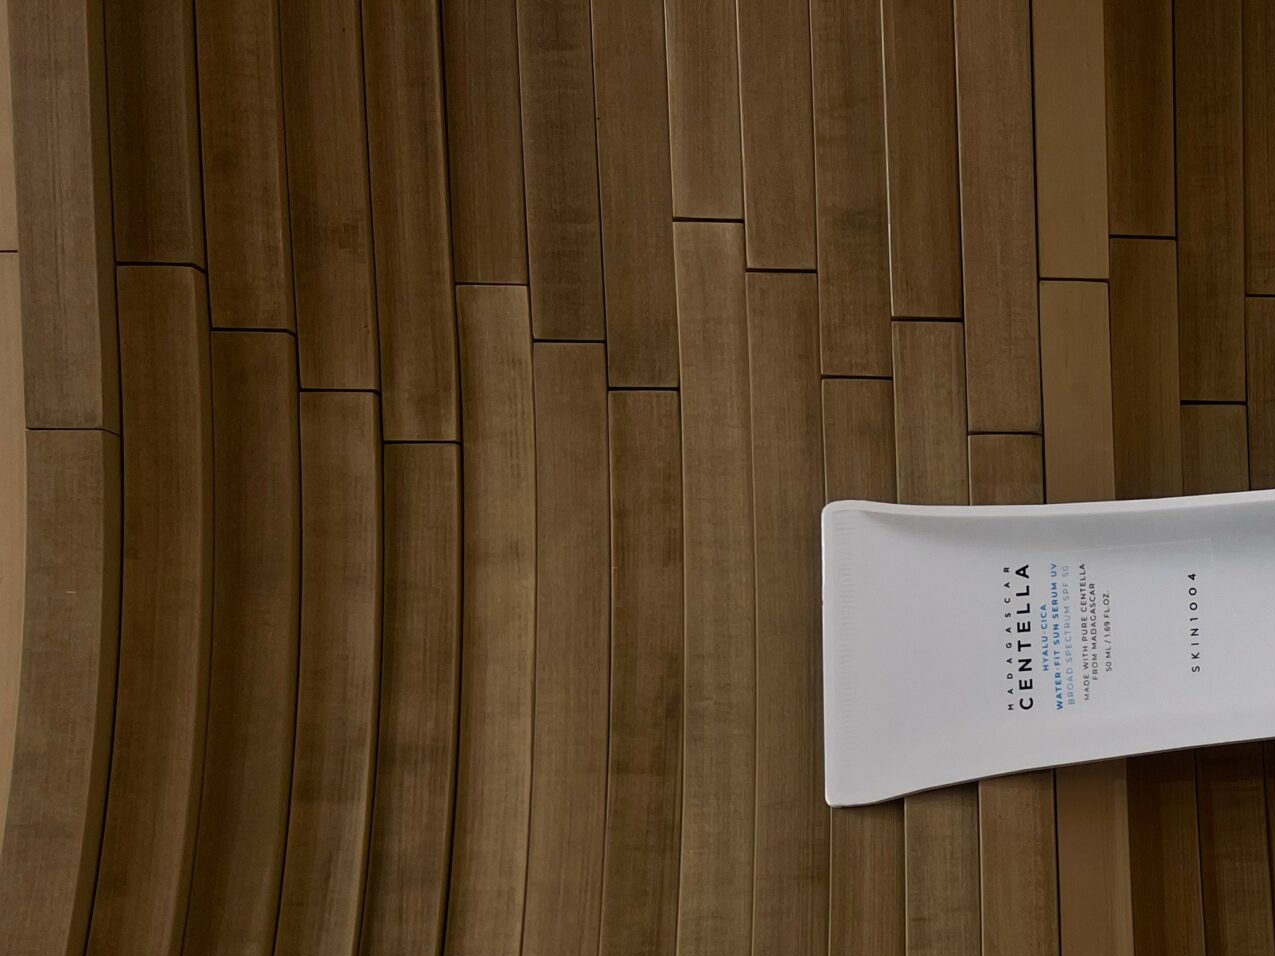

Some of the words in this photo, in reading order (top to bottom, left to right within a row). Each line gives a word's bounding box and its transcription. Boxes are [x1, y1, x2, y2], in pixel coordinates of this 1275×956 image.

[1050, 563, 1058, 577] UV
[1079, 563, 1087, 613] CENTELLA
[1050, 582, 1059, 619] SERUM
[1062, 582, 1070, 601] SPF
[1052, 623, 1060, 645] SUN
[1063, 605, 1073, 663] SPECTRUM
[1080, 616, 1088, 641] PURE
[1089, 583, 1098, 649] MADAGASCAR
[1188, 572, 1201, 673] SKIN1004
[1003, 566, 1014, 711] MADAGASCAR
[1015, 564, 1034, 710] CENTELLA
[1040, 604, 1049, 671] HYALU-CICA
[1104, 646, 1112, 658] ML
[1052, 650, 1064, 710] WATER-FIT
[1105, 661, 1112, 672] 50
[1066, 667, 1076, 705] BROAD
[1082, 674, 1090, 701] MADE
